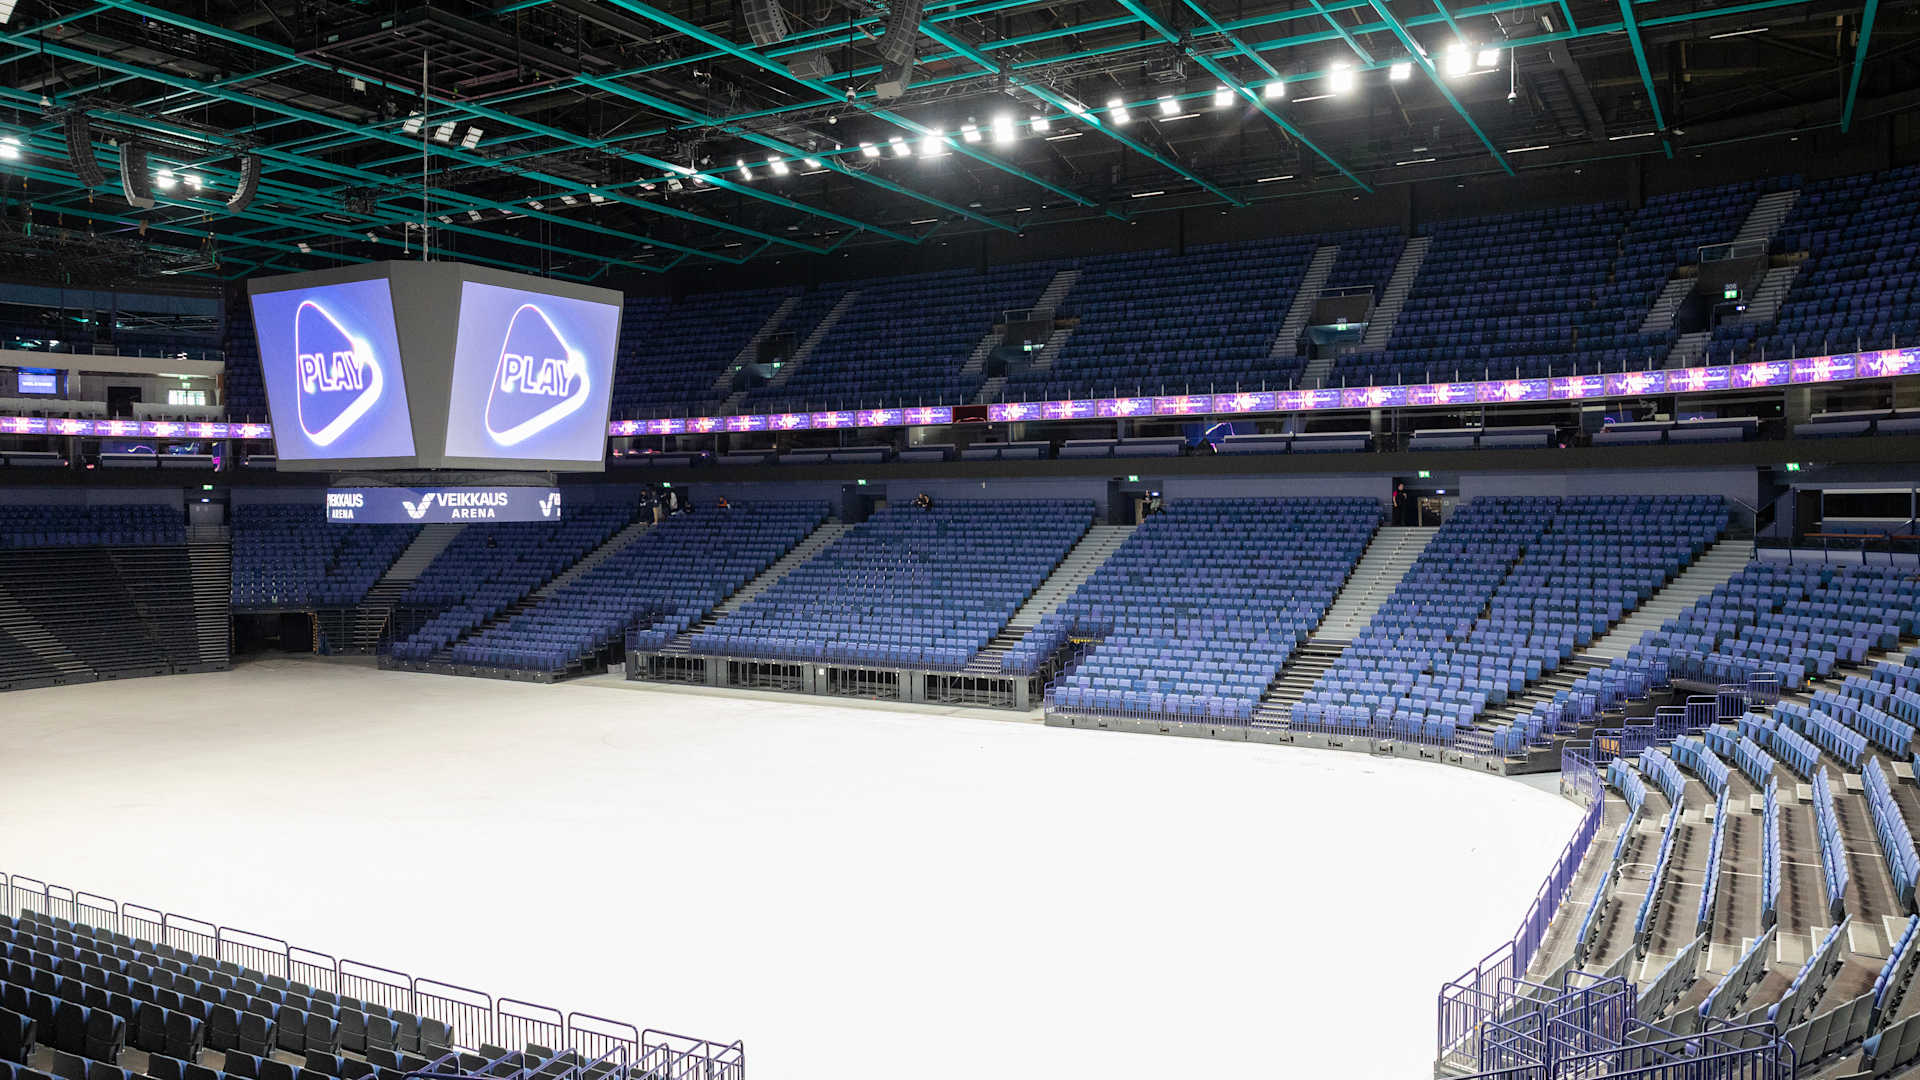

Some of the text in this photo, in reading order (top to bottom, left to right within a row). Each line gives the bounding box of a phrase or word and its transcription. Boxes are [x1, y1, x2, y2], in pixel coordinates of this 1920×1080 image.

[300, 351, 363, 394] PLAY
[501, 353, 574, 397] PLAY
[436, 492, 508, 507] VEIKKAUS
[451, 508, 496, 518] ARENA
